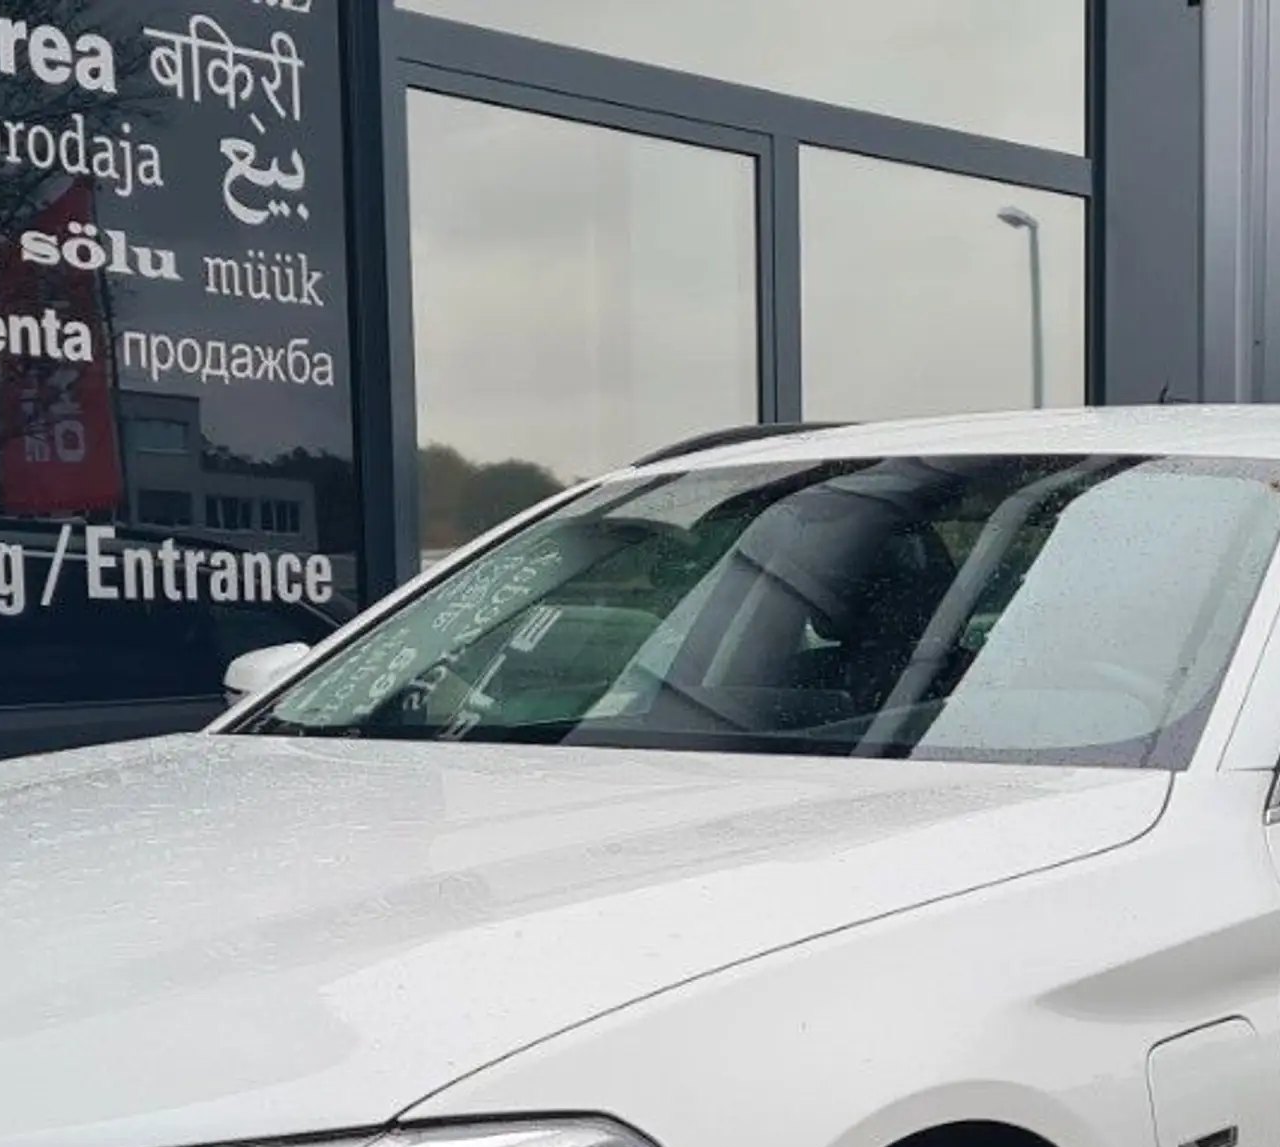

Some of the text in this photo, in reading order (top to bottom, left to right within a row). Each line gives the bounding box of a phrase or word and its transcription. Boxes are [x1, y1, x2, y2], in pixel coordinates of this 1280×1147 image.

[20, 221, 182, 281] sölu
[203, 249, 324, 307] müük
[123, 331, 334, 386] продажба
[84, 526, 332, 603] Entrance
